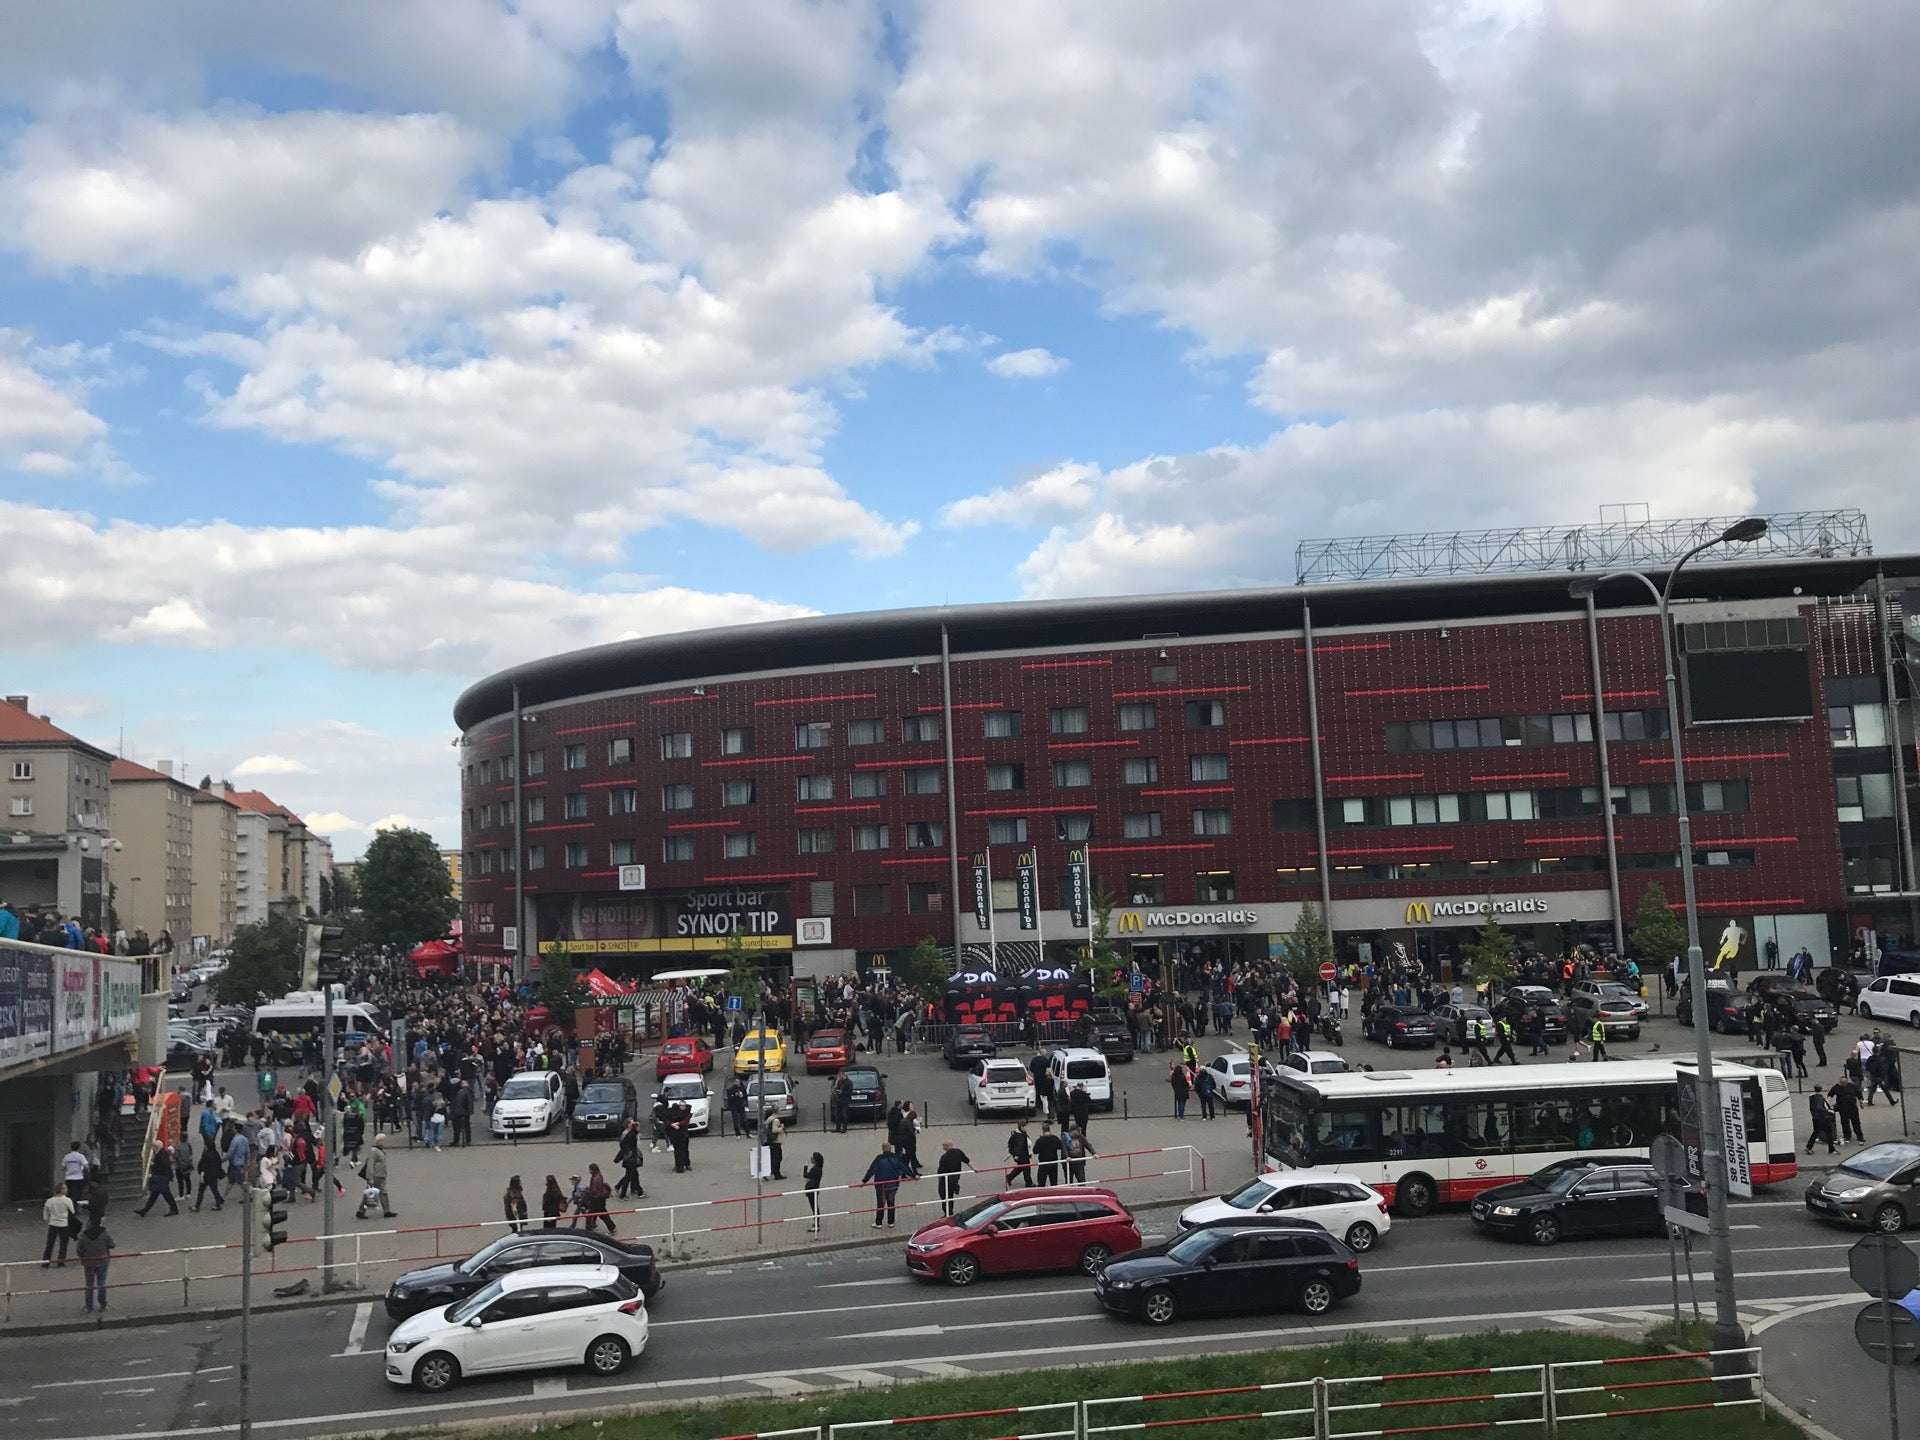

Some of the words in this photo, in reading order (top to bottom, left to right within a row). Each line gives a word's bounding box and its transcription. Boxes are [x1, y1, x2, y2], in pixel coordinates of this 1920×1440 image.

[687, 888, 732, 911] Sport
[736, 887, 764, 907] bar
[1433, 898, 1548, 916] McDonald's
[677, 912, 740, 934] SYNOT
[748, 911, 779, 932] TIP
[1147, 909, 1258, 927] McDonald's
[1730, 1095, 1741, 1121] PRE
[1733, 1124, 1743, 1140] od
[1736, 1143, 1749, 1185] panely
[1729, 1167, 1738, 1182] se
